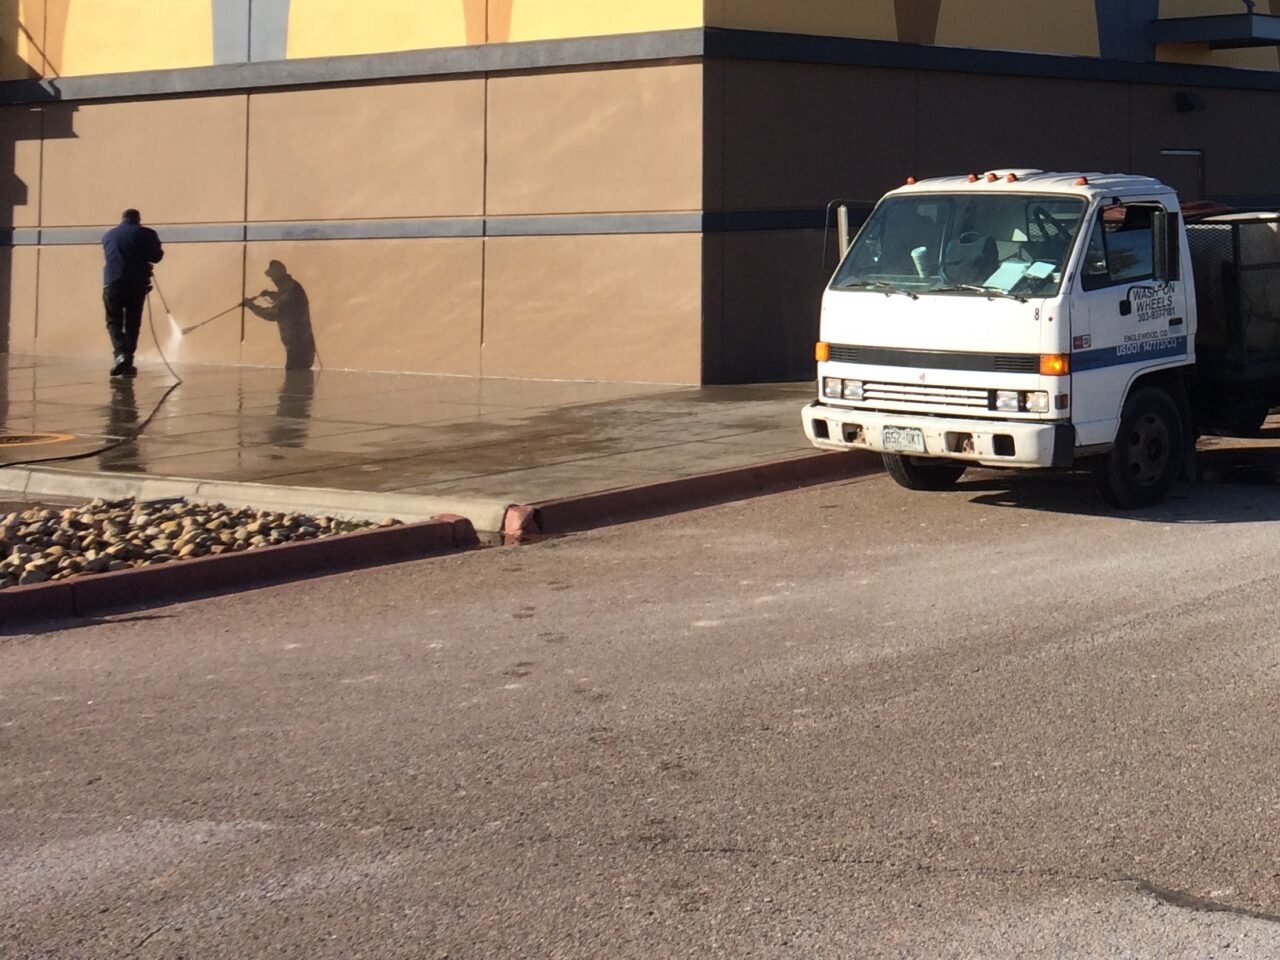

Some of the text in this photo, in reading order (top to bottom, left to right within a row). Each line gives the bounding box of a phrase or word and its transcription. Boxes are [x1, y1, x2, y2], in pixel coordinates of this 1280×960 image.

[1137, 296, 1172, 312] WHEELS
[1034, 307, 1040, 321] 8
[1117, 343, 1141, 356] USDOT
